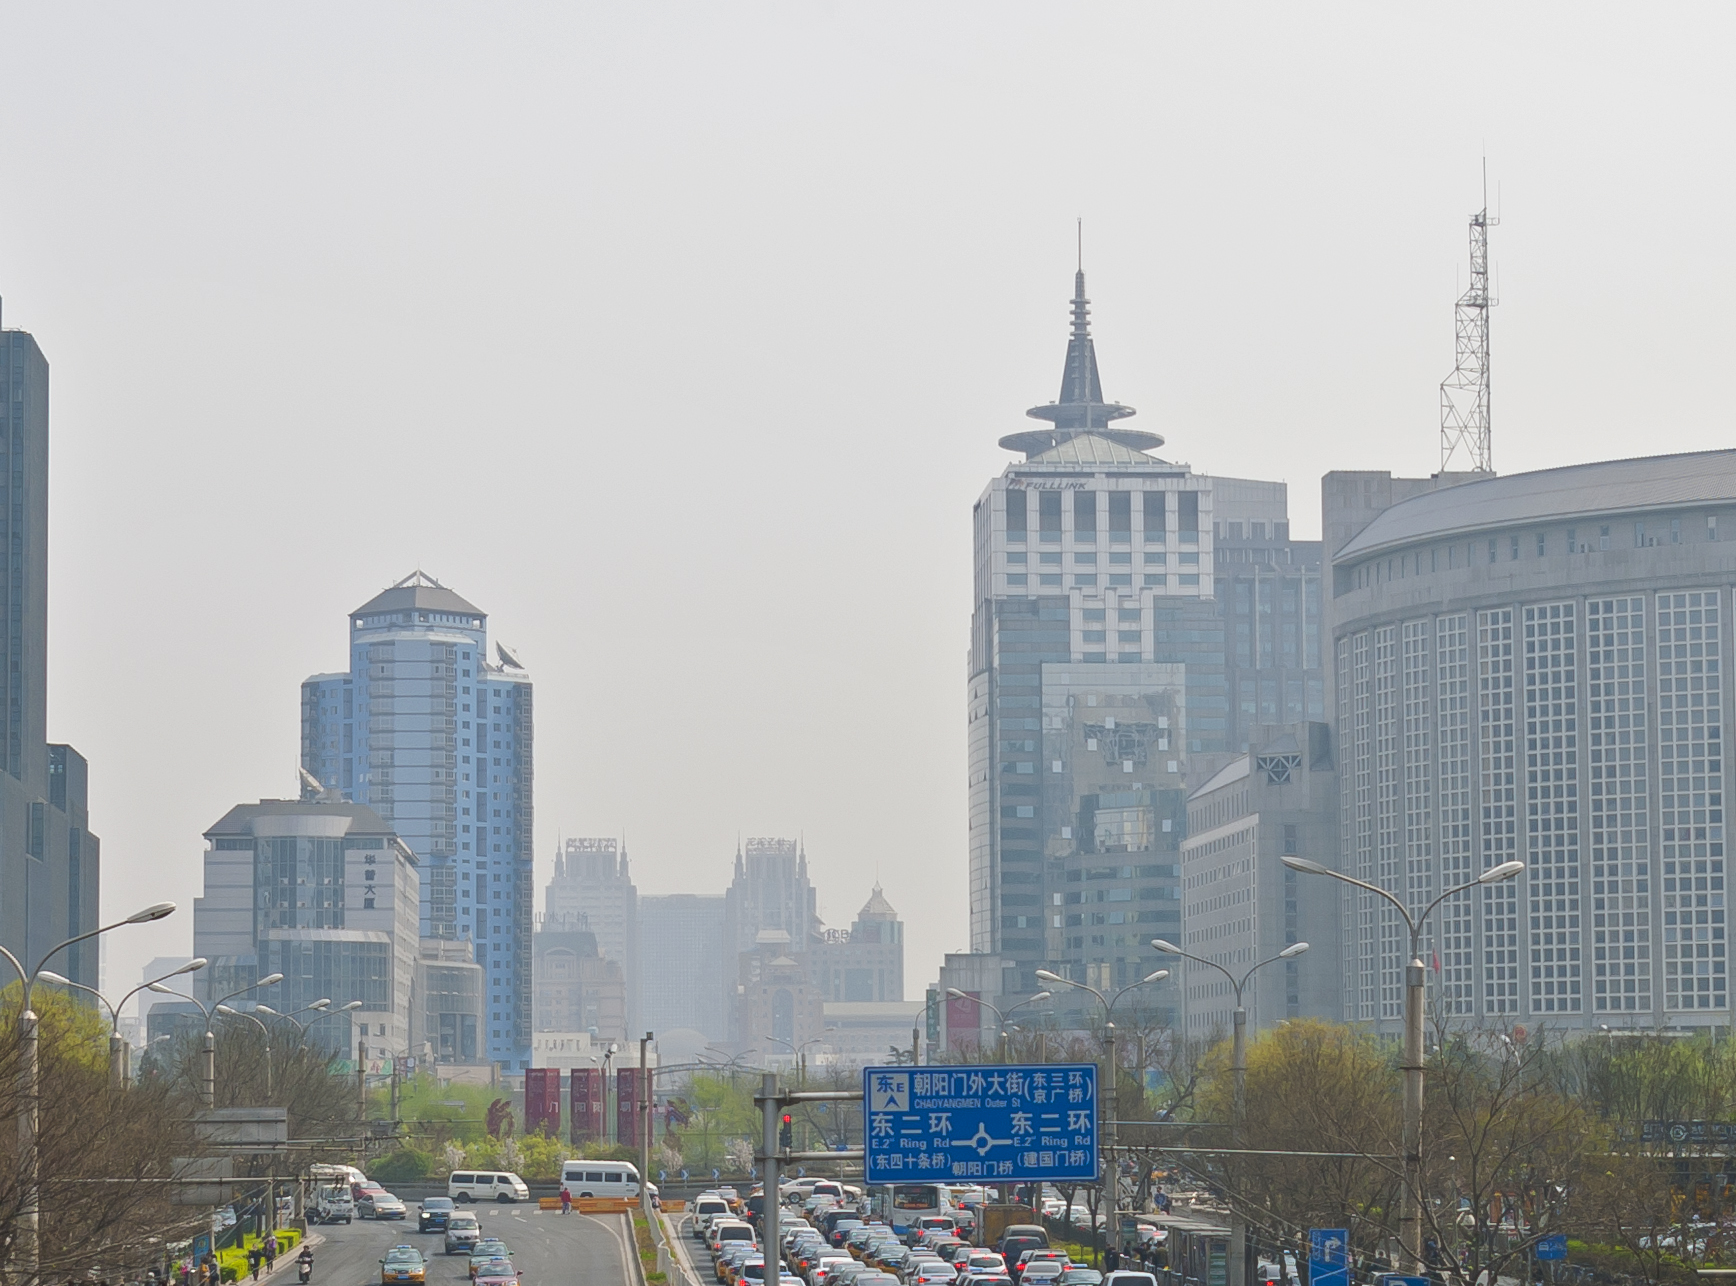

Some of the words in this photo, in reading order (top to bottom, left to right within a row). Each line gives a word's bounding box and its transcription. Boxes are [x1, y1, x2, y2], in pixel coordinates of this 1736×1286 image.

[876, 1075, 894, 1093] 东
[896, 1082, 905, 1093] E
[913, 1072, 1024, 1096] 朝阳门外大街
[914, 1098, 981, 1109] CHAOYANGMEN
[985, 1097, 1008, 1108] Outer
[1011, 1097, 1021, 1108] St
[870, 1112, 953, 1136] 东二环
[1010, 1110, 1091, 1134] 东二环
[900, 1138, 927, 1150] Ring
[933, 1137, 950, 1148] Rd
[1041, 1136, 1068, 1148] Ring
[1074, 1135, 1091, 1146] Rd
[952, 1160, 1014, 1176] 朝阳门桥
